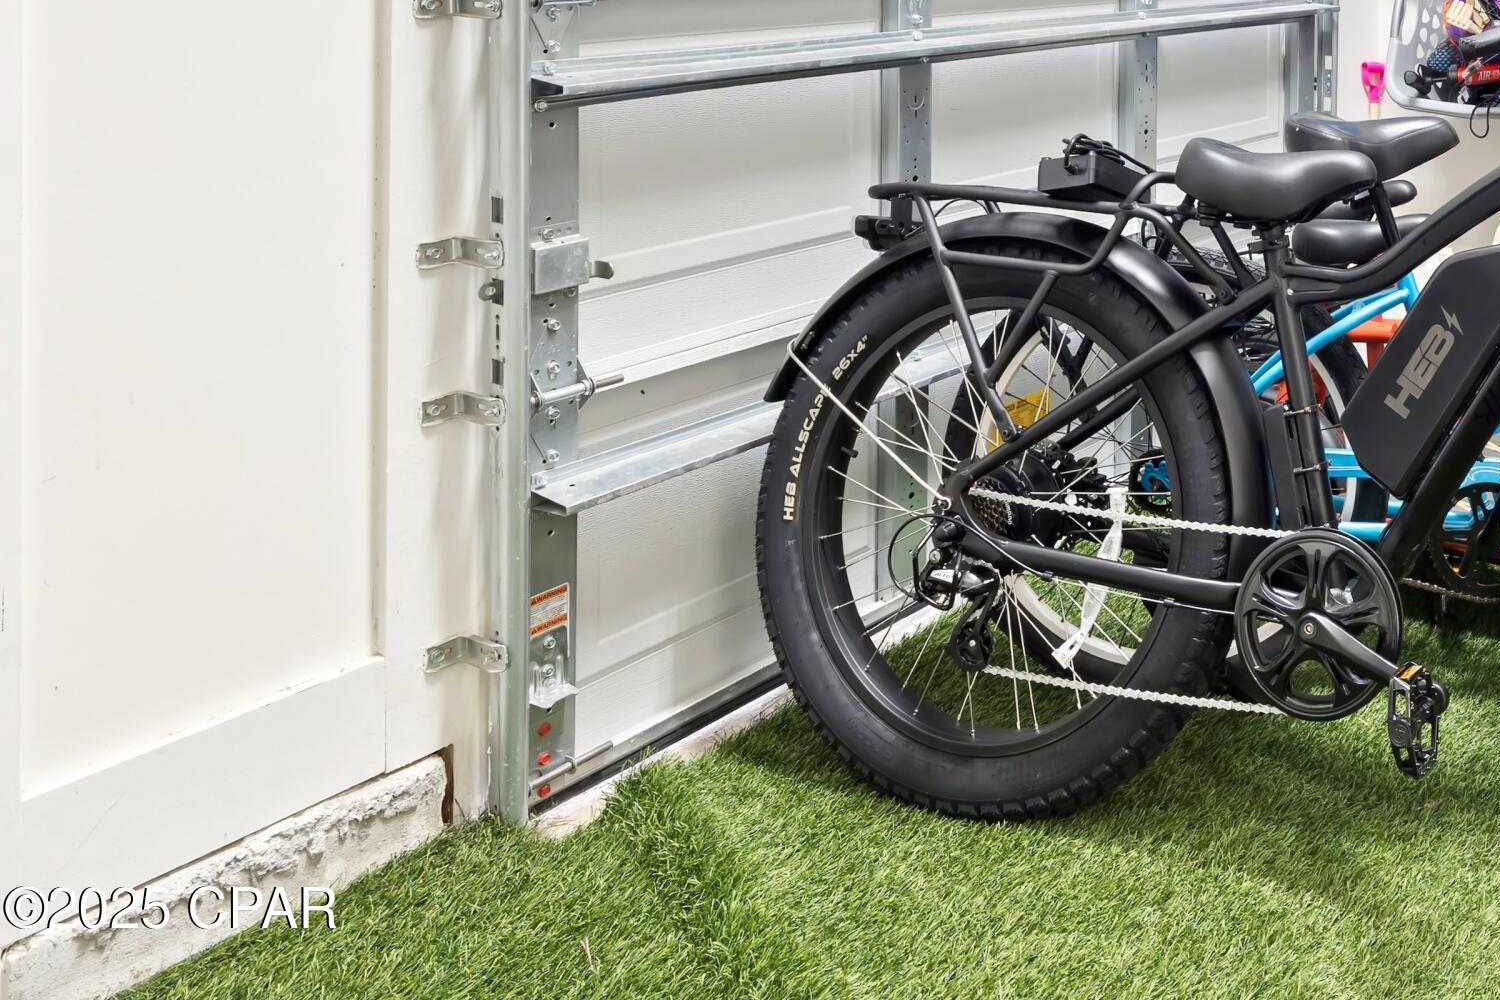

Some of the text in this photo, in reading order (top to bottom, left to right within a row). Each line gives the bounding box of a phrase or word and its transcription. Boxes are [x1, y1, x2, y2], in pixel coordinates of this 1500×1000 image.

[1384, 324, 1455, 419] HEB
[789, 383, 831, 478] ALLSCAPE
[783, 482, 797, 521] HEB
